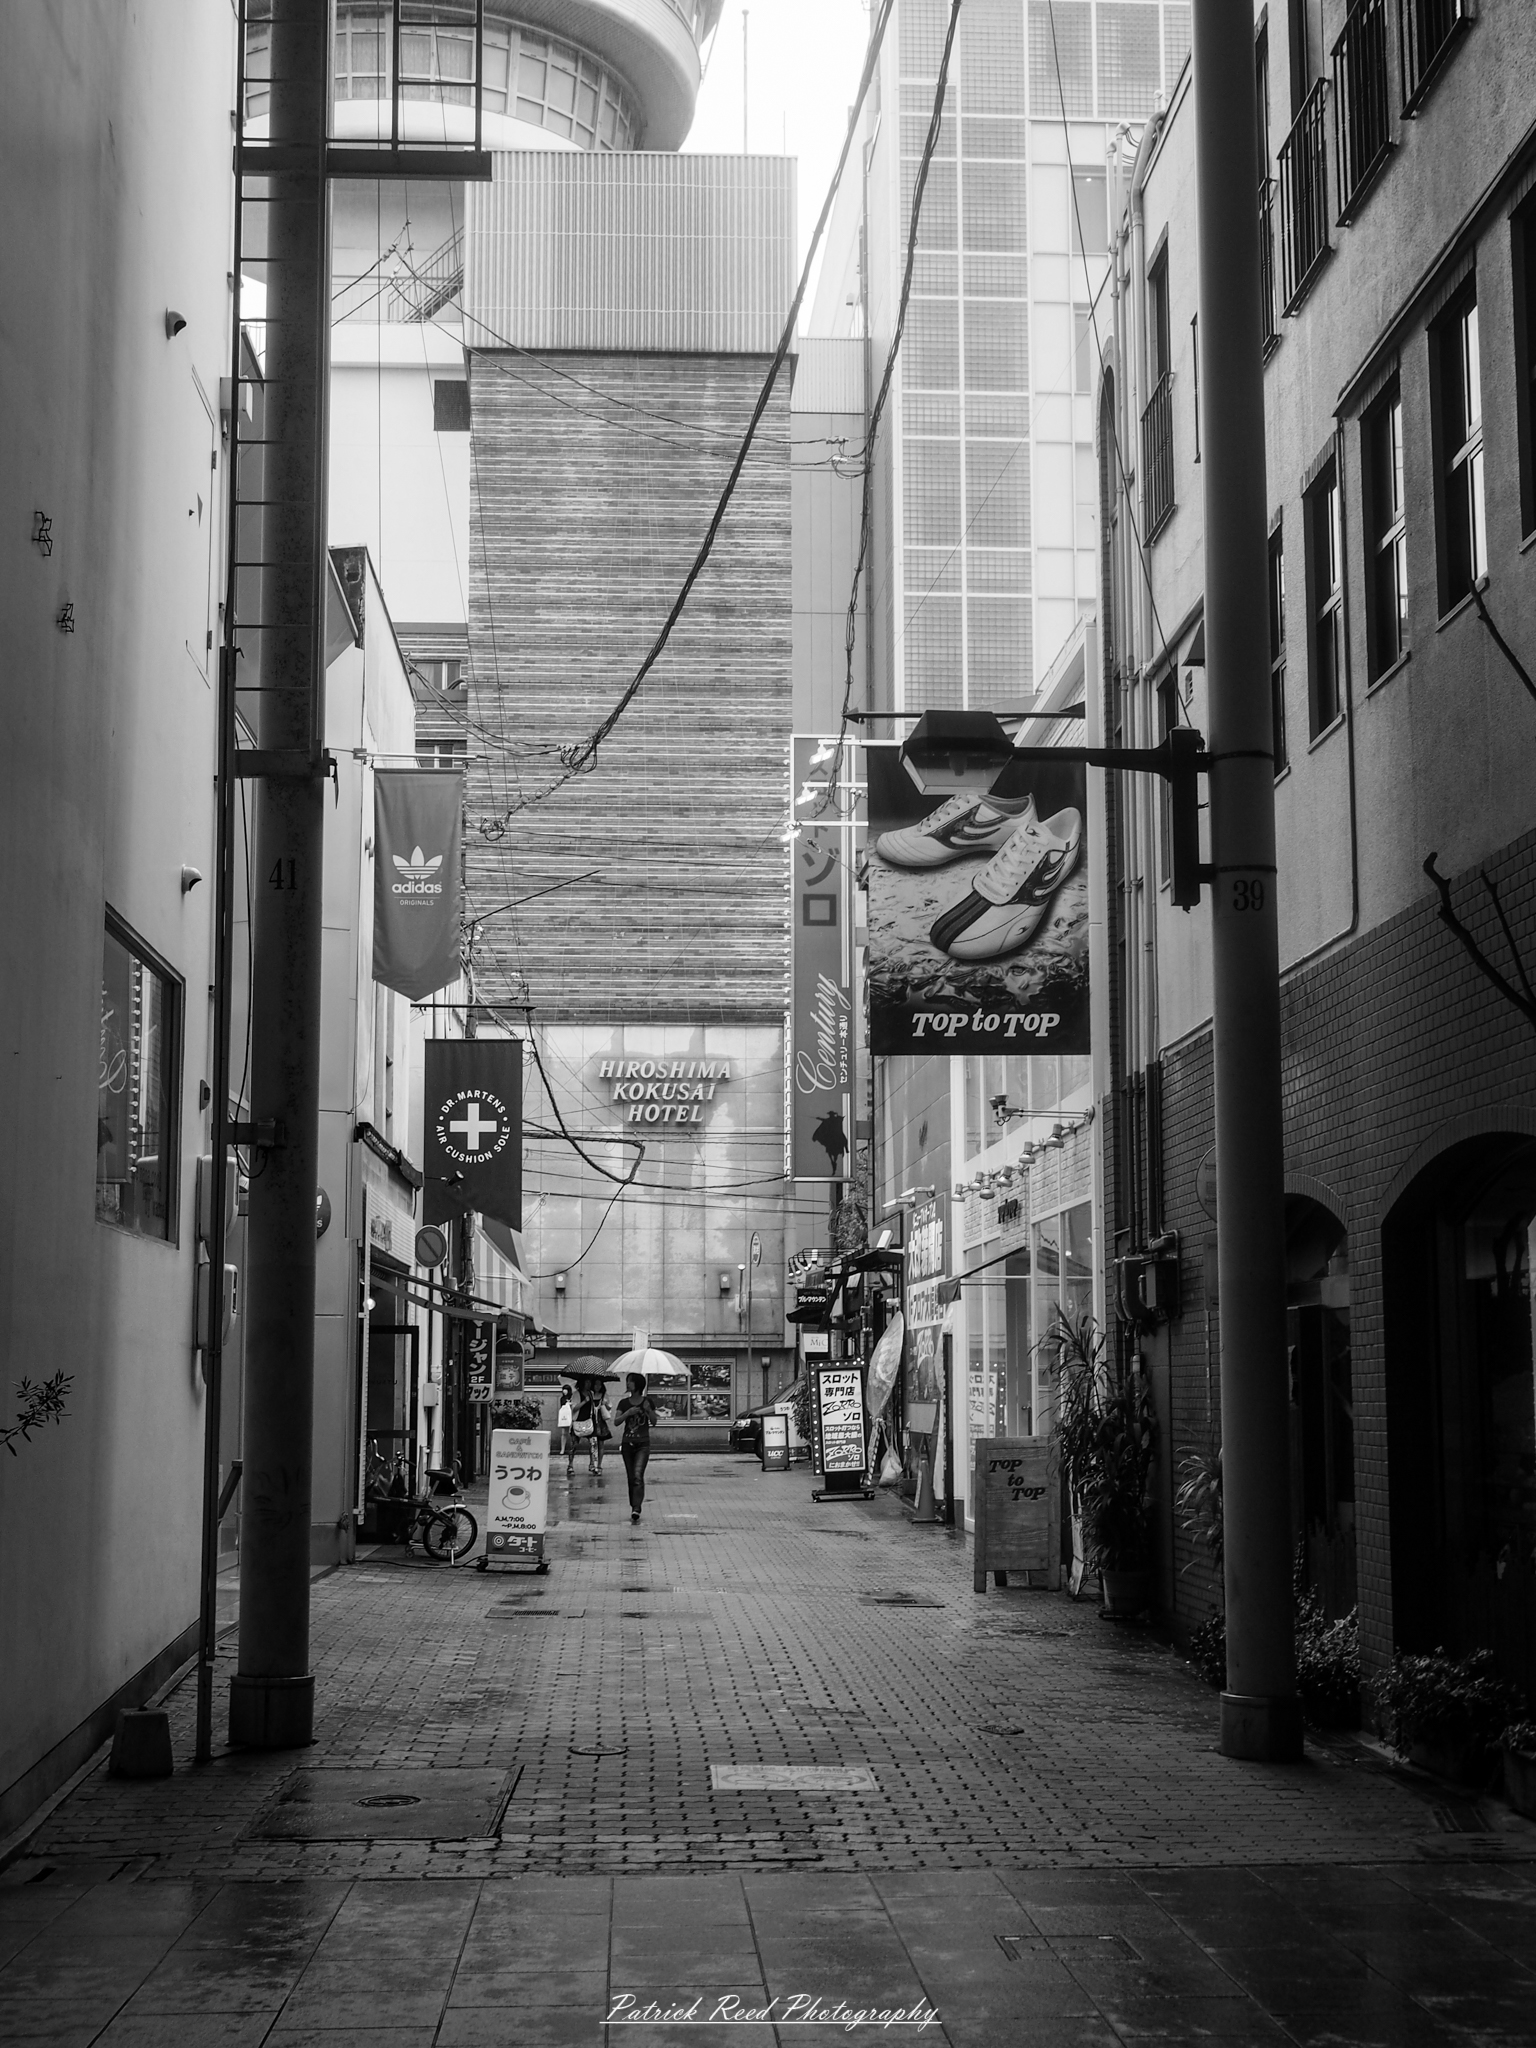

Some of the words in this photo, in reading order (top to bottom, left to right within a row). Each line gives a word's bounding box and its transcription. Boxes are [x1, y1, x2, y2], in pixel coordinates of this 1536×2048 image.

[268, 858, 298, 890] 41
[392, 880, 442, 894] adidas
[1233, 879, 1264, 911] 39
[971, 1008, 1000, 1032] to
[796, 973, 851, 1094] Century
[598, 1060, 731, 1078] HIROSHIMA
[613, 1082, 716, 1101] KOKUSAI
[627, 1104, 704, 1122] HOTEL
[435, 1125, 448, 1144] AIR
[445, 1145, 493, 1164] CUSHION
[493, 1126, 511, 1153] SOLE
[470, 1375, 485, 1383] 2F
[822, 1373, 858, 1384] スロット
[824, 1386, 855, 1397] 専門店
[495, 1465, 542, 1481] うつわ
[1007, 1474, 1024, 1487] to
